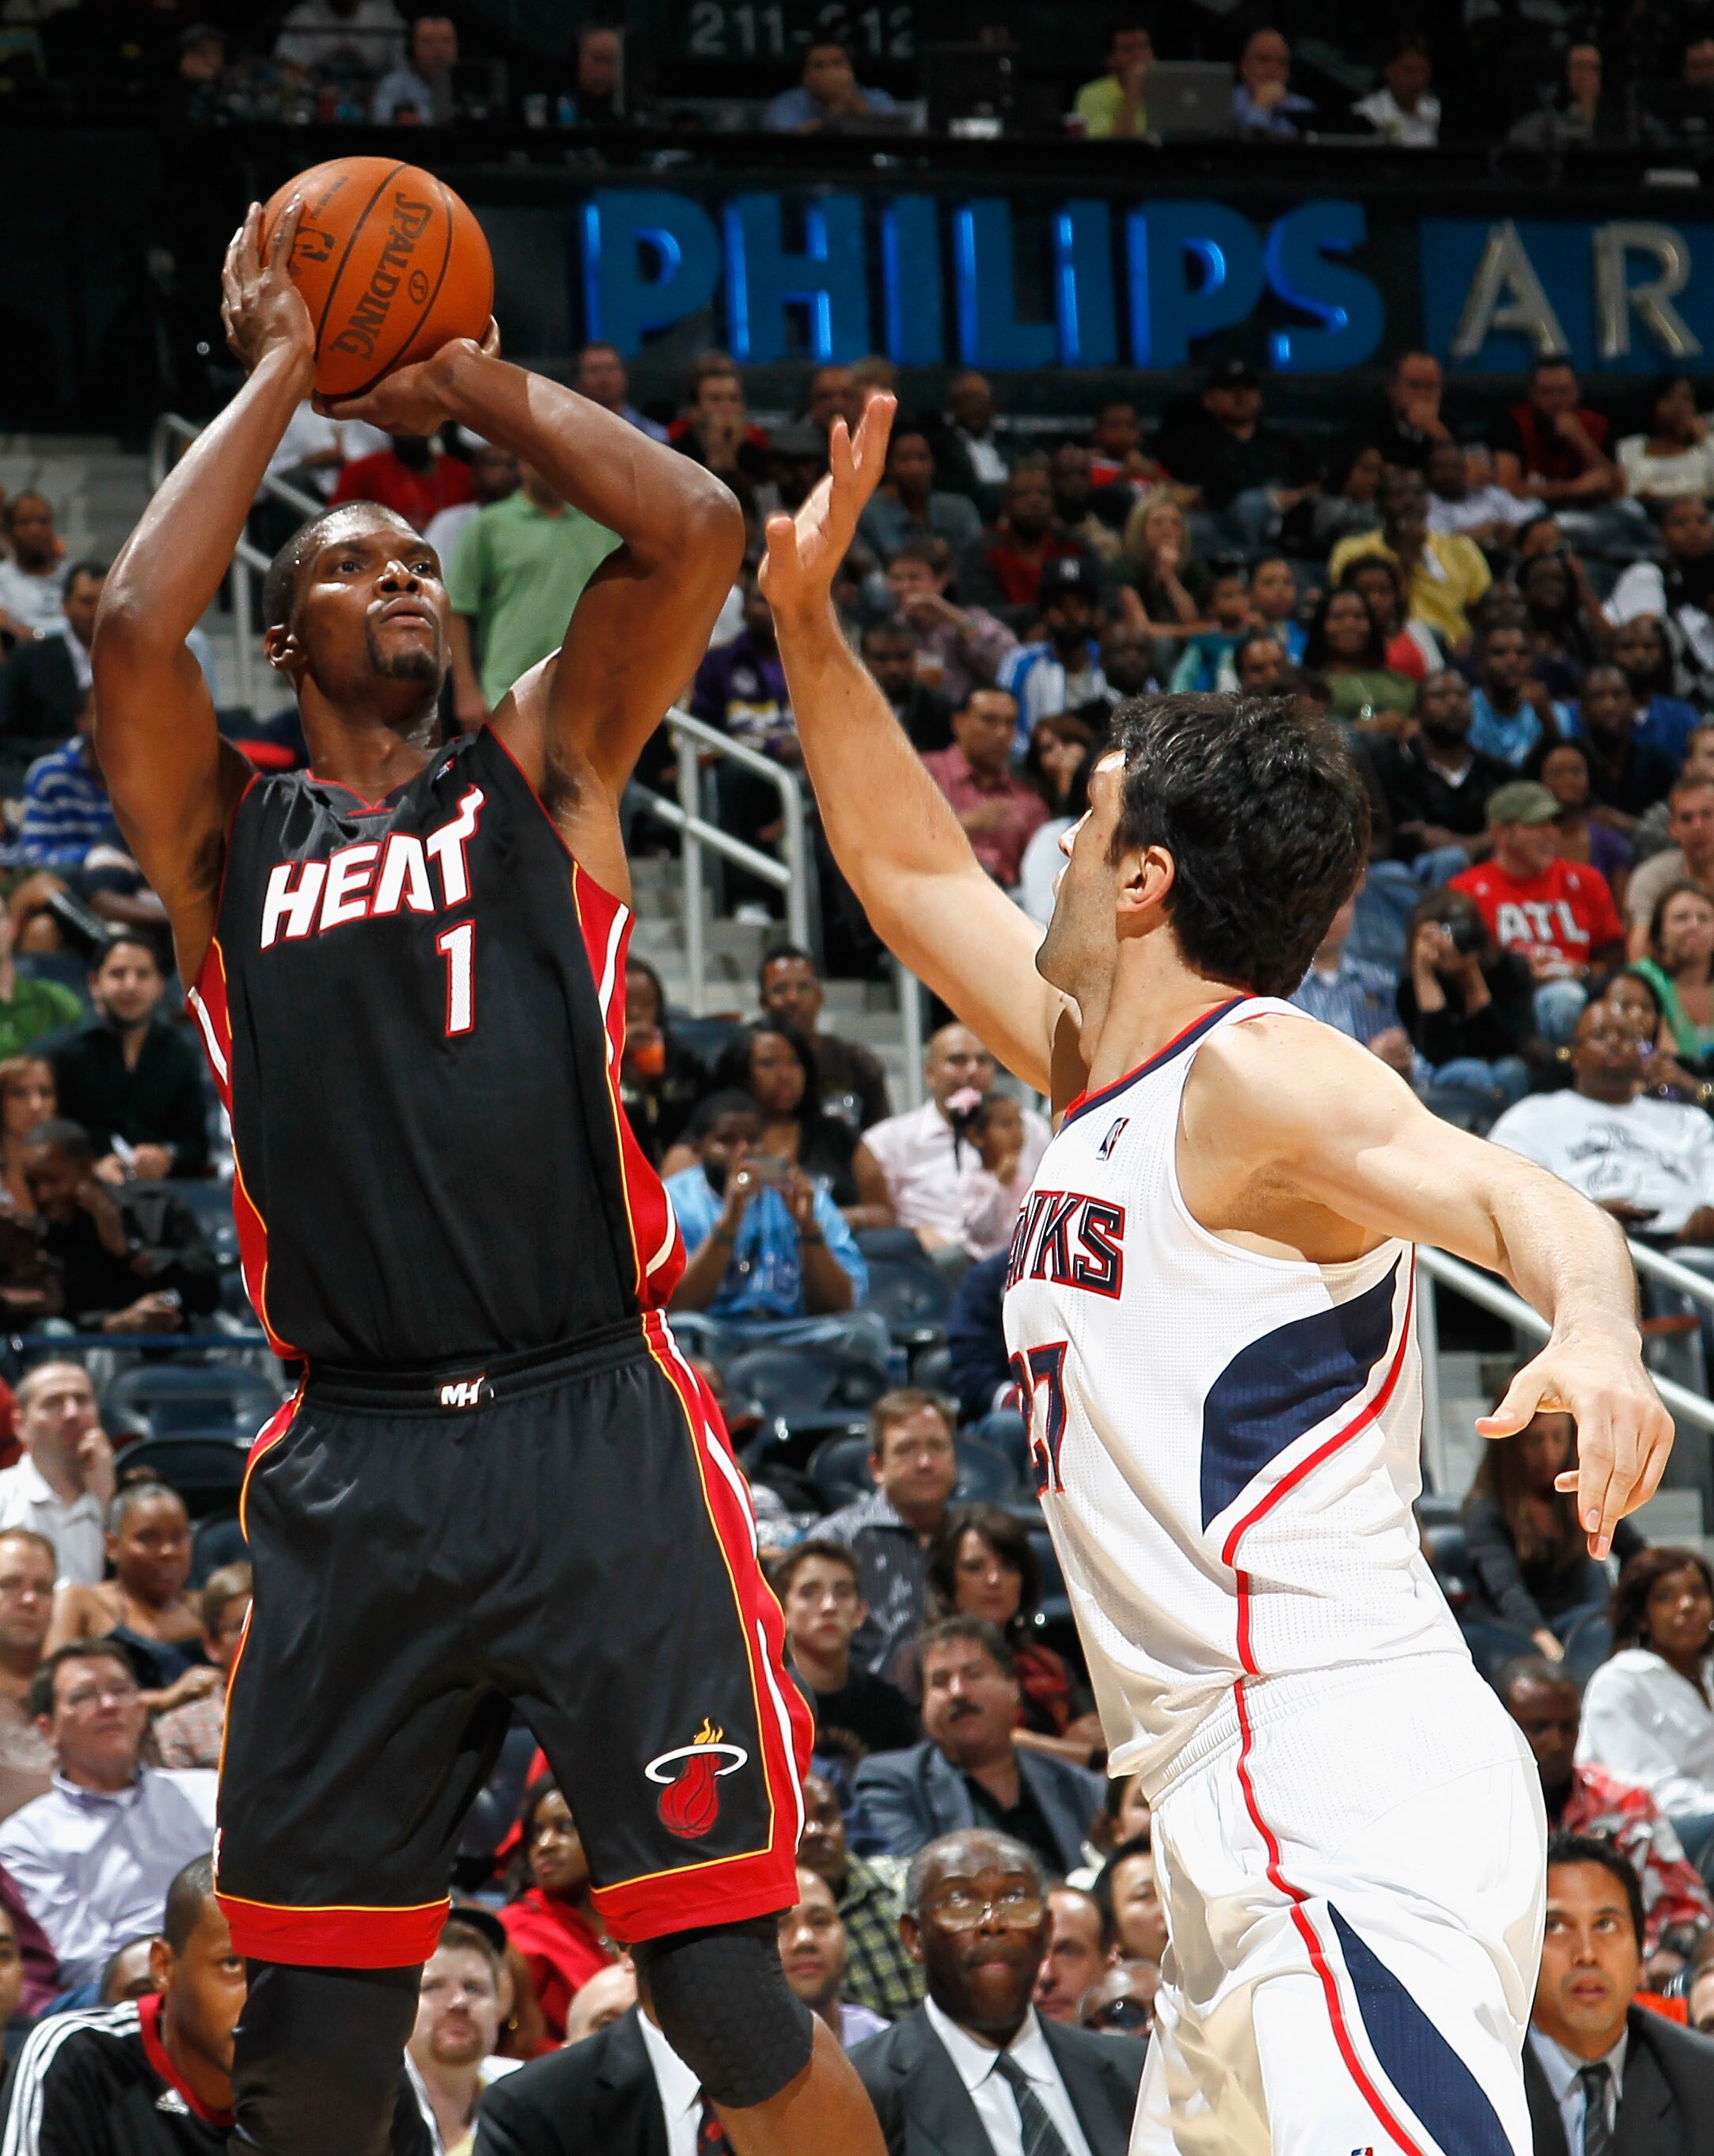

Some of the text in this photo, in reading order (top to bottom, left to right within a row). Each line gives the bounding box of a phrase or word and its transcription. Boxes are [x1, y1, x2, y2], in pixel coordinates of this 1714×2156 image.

[328, 192, 434, 360] SPALDING
[583, 190, 1386, 374] PHILIPS
[260, 784, 486, 951] HEAT
[1496, 901, 1590, 947] ATL
[436, 920, 475, 1037] 1
[439, 1375, 485, 1409] MH
